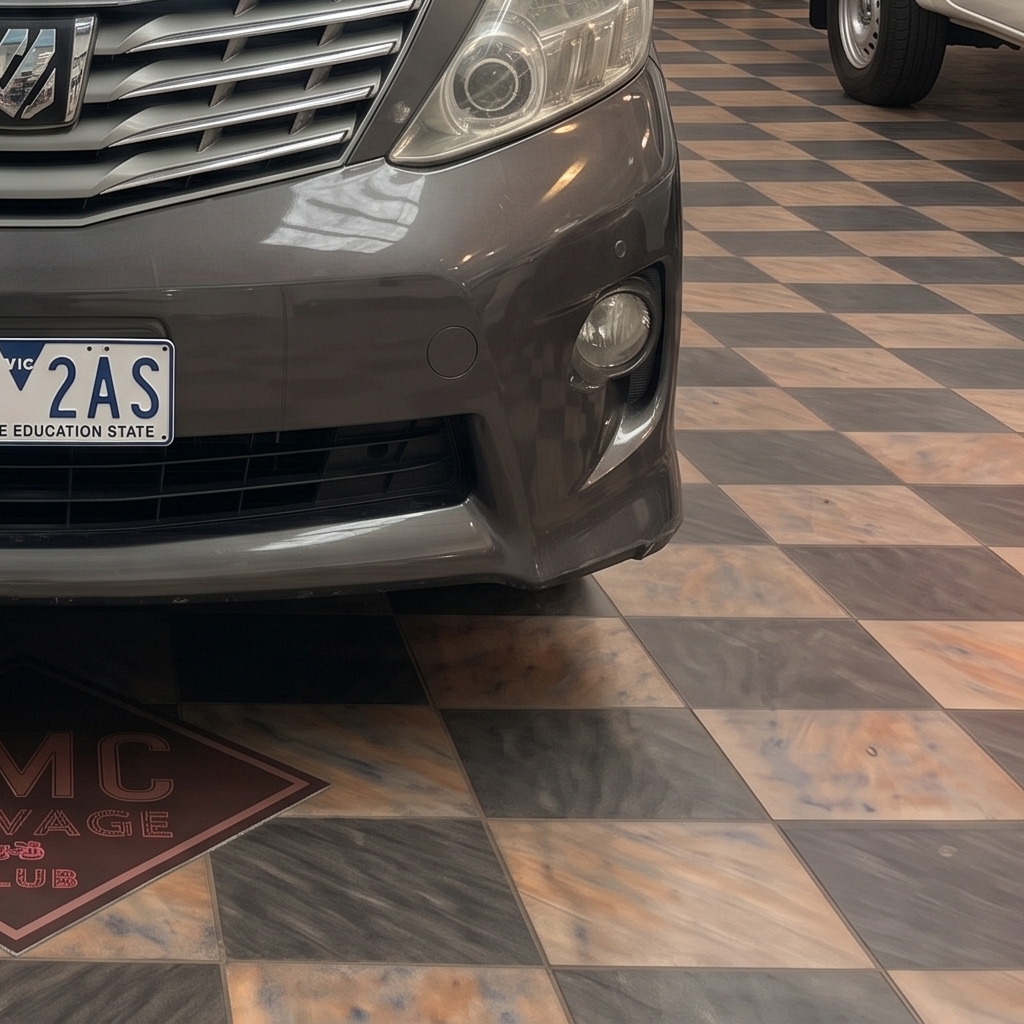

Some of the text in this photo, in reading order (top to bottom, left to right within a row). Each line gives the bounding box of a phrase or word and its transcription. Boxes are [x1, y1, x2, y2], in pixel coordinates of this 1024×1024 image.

[4, 358, 34, 371] VIC
[48, 356, 160, 419] 2AS
[13, 424, 103, 438] EDUCATION
[107, 424, 155, 438] STATE
